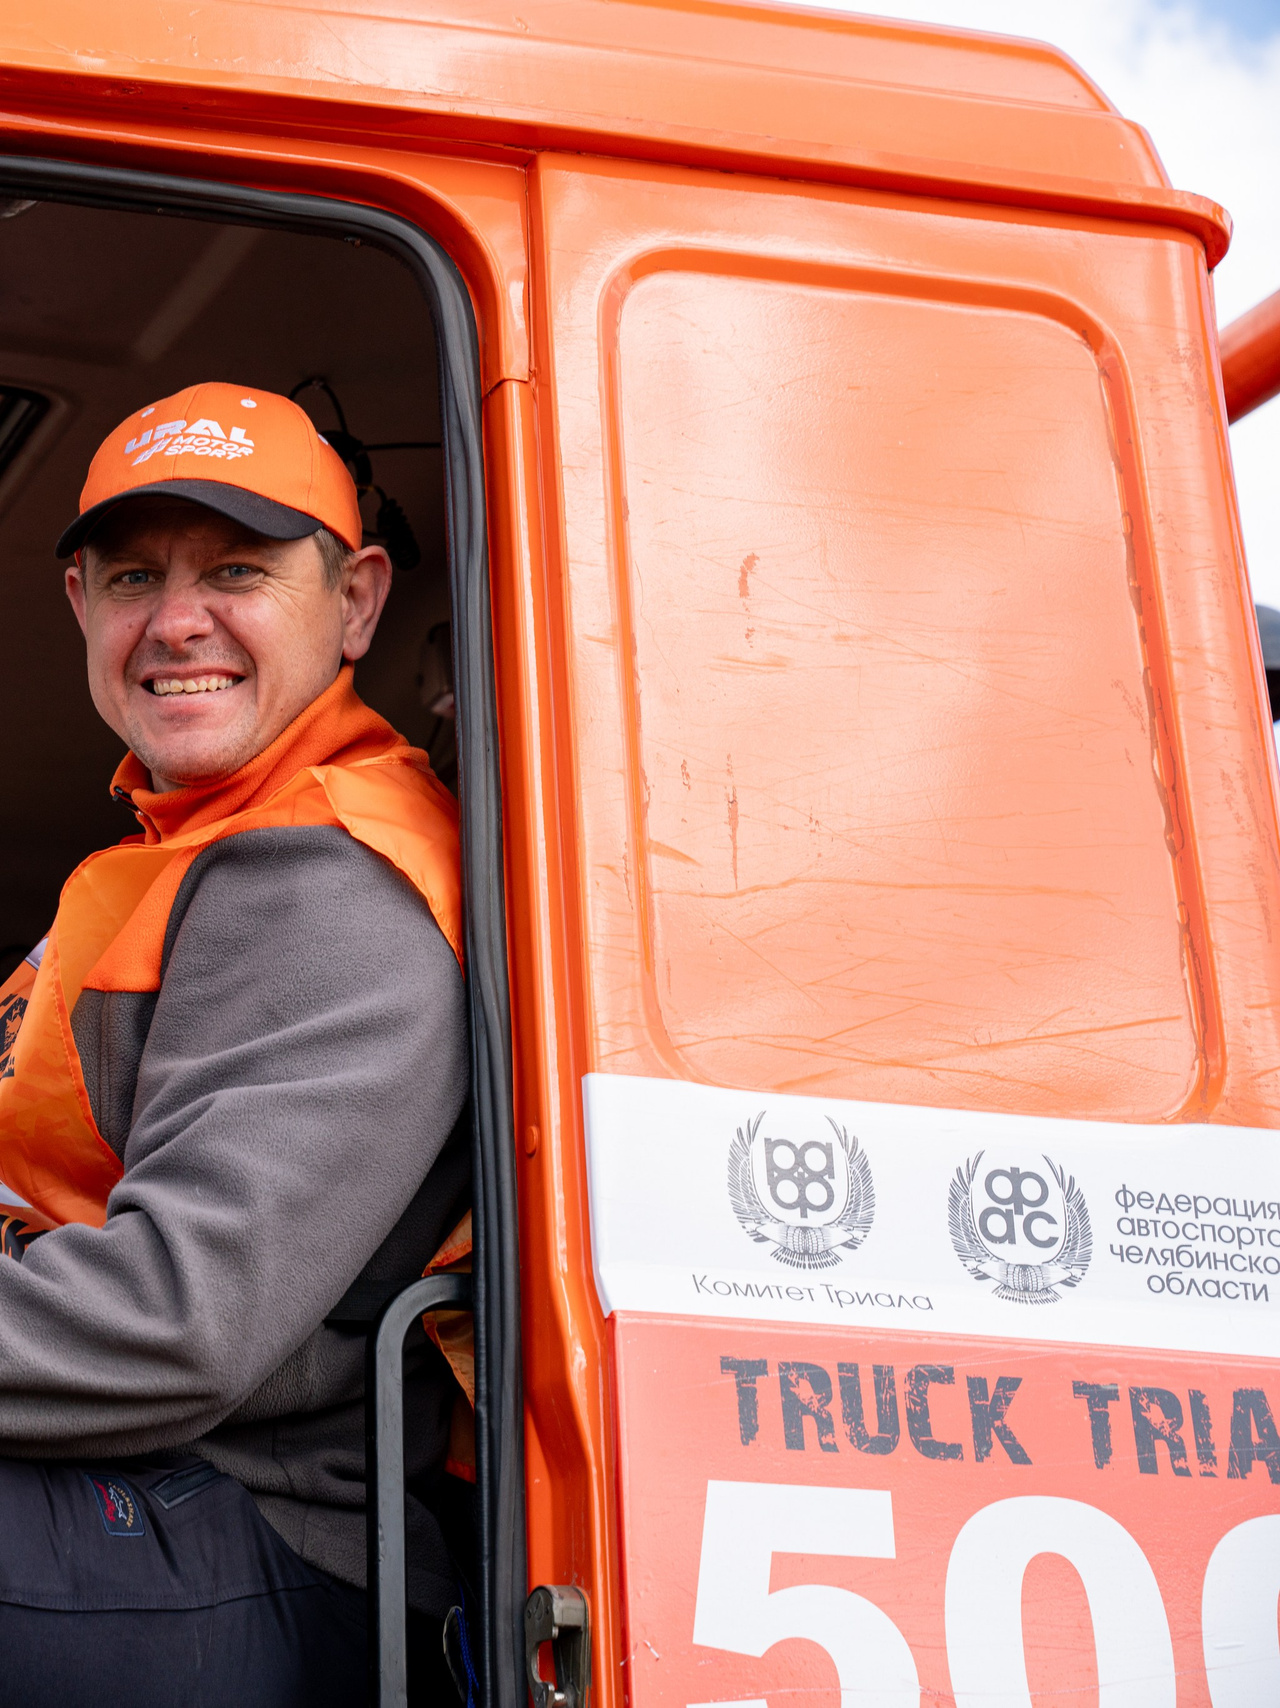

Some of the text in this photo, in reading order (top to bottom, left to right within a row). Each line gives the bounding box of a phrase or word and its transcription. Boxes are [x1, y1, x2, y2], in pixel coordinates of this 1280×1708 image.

[124, 418, 255, 455] URAL
[164, 445, 242, 460] SPORT
[172, 434, 254, 456] MOTOR
[1115, 1184, 1280, 1222] федерация
[691, 1273, 934, 1311] Комитет Триала
[1146, 1271, 1269, 1302] области
[720, 1355, 1280, 1485] TRUCK TRIA
[686, 1479, 1280, 1708] 50
